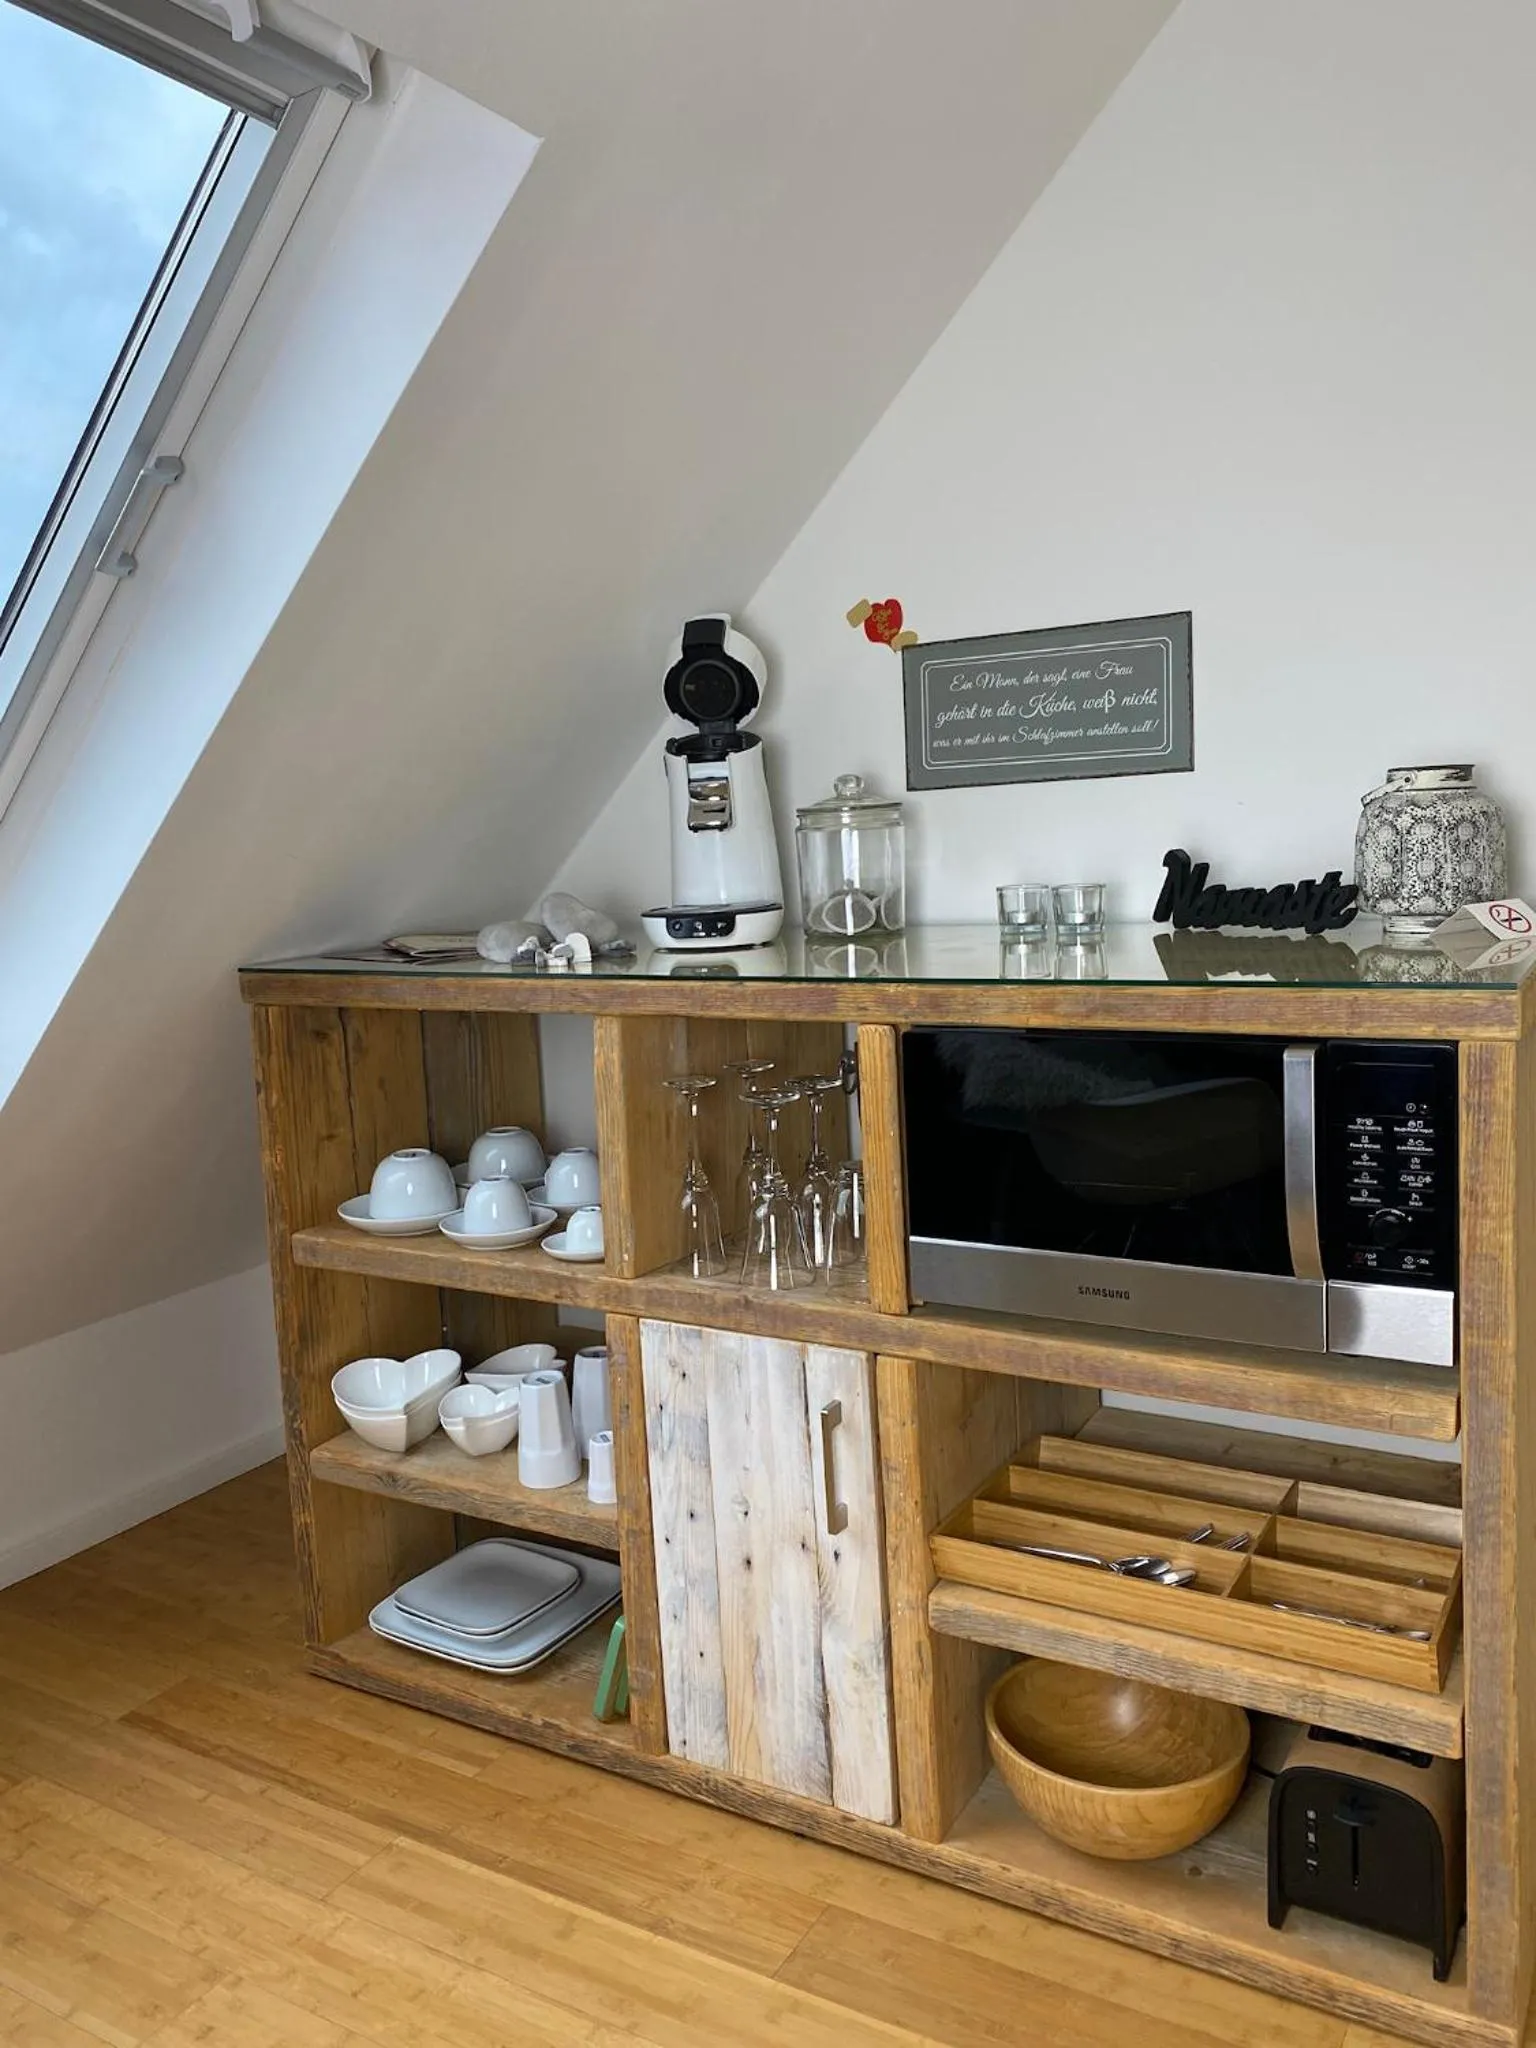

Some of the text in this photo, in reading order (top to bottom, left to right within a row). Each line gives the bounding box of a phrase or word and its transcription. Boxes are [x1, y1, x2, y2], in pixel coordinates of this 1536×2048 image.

[949, 673, 973, 691] Ein
[975, 671, 1019, 689] Mann,
[1071, 669, 1092, 680] eine
[1094, 660, 1134, 680] Frau
[934, 702, 979, 729] gehört
[980, 704, 993, 718] in
[996, 699, 1017, 717] die
[1018, 690, 1077, 719] Küche,
[1082, 688, 1117, 714] weiß
[997, 733, 1010, 743] im
[1011, 725, 1084, 745] Schlafzimmer
[1086, 722, 1129, 737] anstellen
[1078, 1286, 1131, 1301] SAMSUNG
